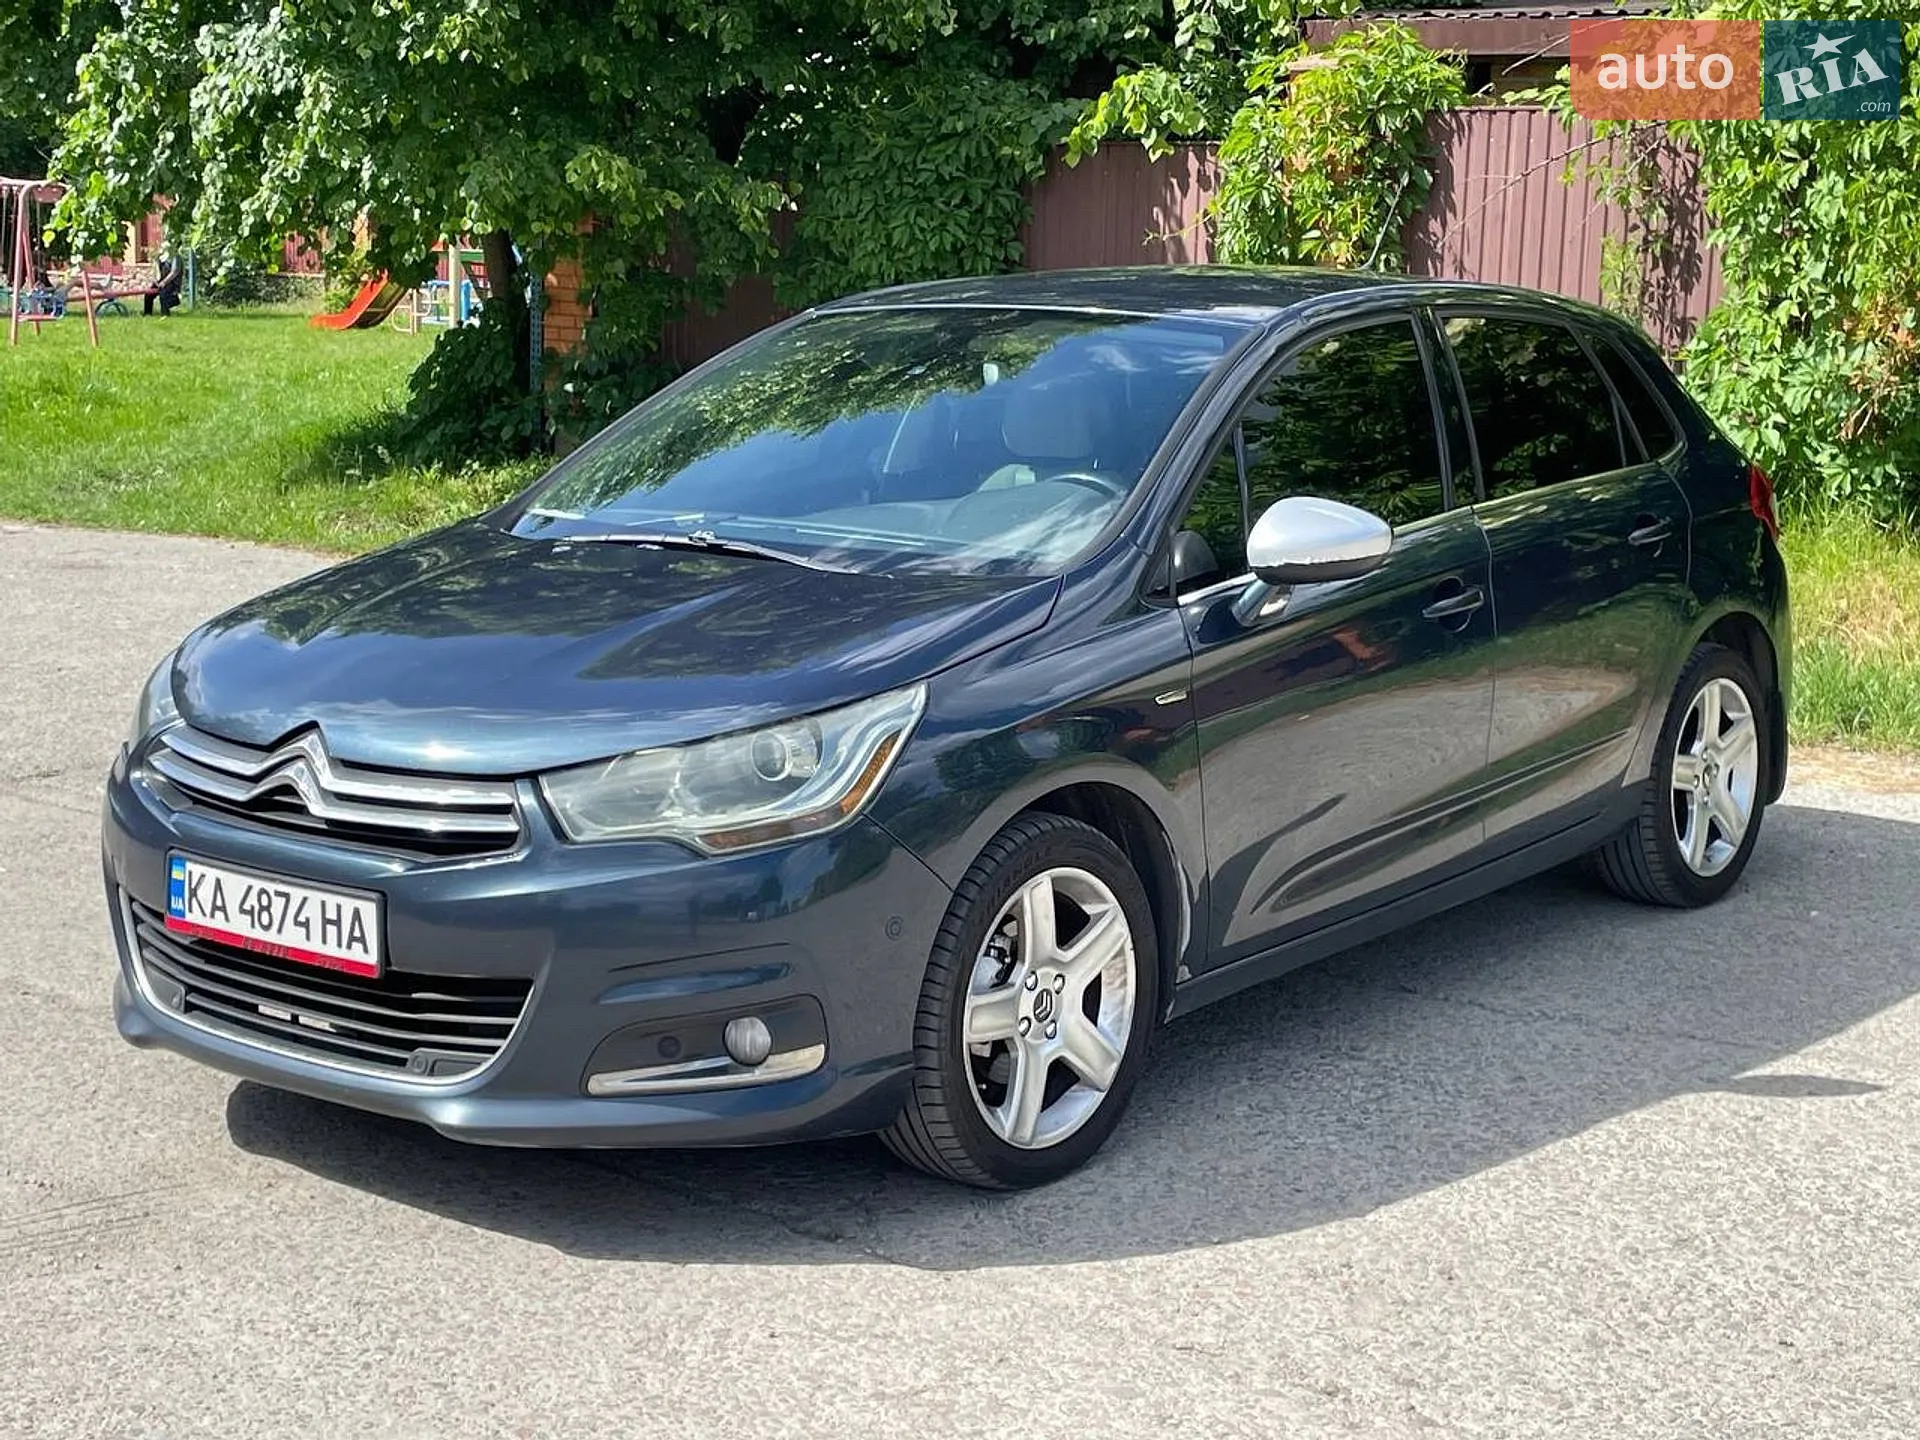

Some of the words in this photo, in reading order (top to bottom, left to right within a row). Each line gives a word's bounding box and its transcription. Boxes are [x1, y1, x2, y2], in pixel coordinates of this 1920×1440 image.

[171, 896, 184, 910] UA
[188, 870, 230, 922] KA
[239, 885, 310, 942] 4874
[321, 900, 368, 954] HA
